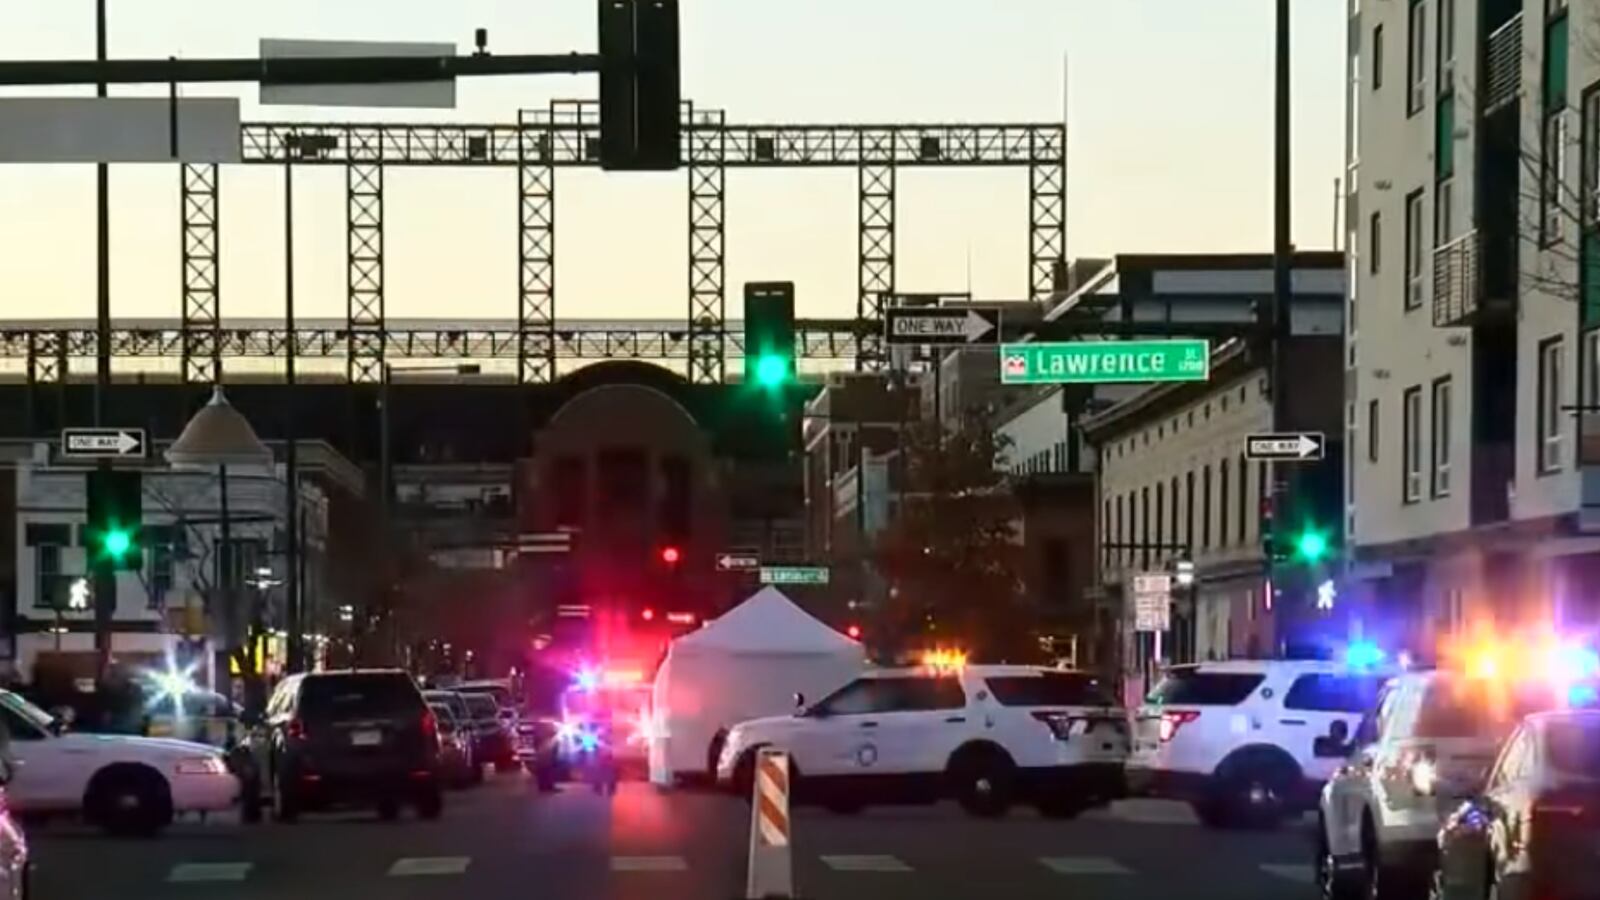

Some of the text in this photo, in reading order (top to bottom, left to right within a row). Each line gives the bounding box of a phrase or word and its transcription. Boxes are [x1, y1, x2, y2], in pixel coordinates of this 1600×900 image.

[897, 318, 965, 334] ONE WAY
[1036, 351, 1166, 374] Lawrence
[71, 437, 118, 448] ONE WAY
[1253, 442, 1300, 452] ONE WAY
